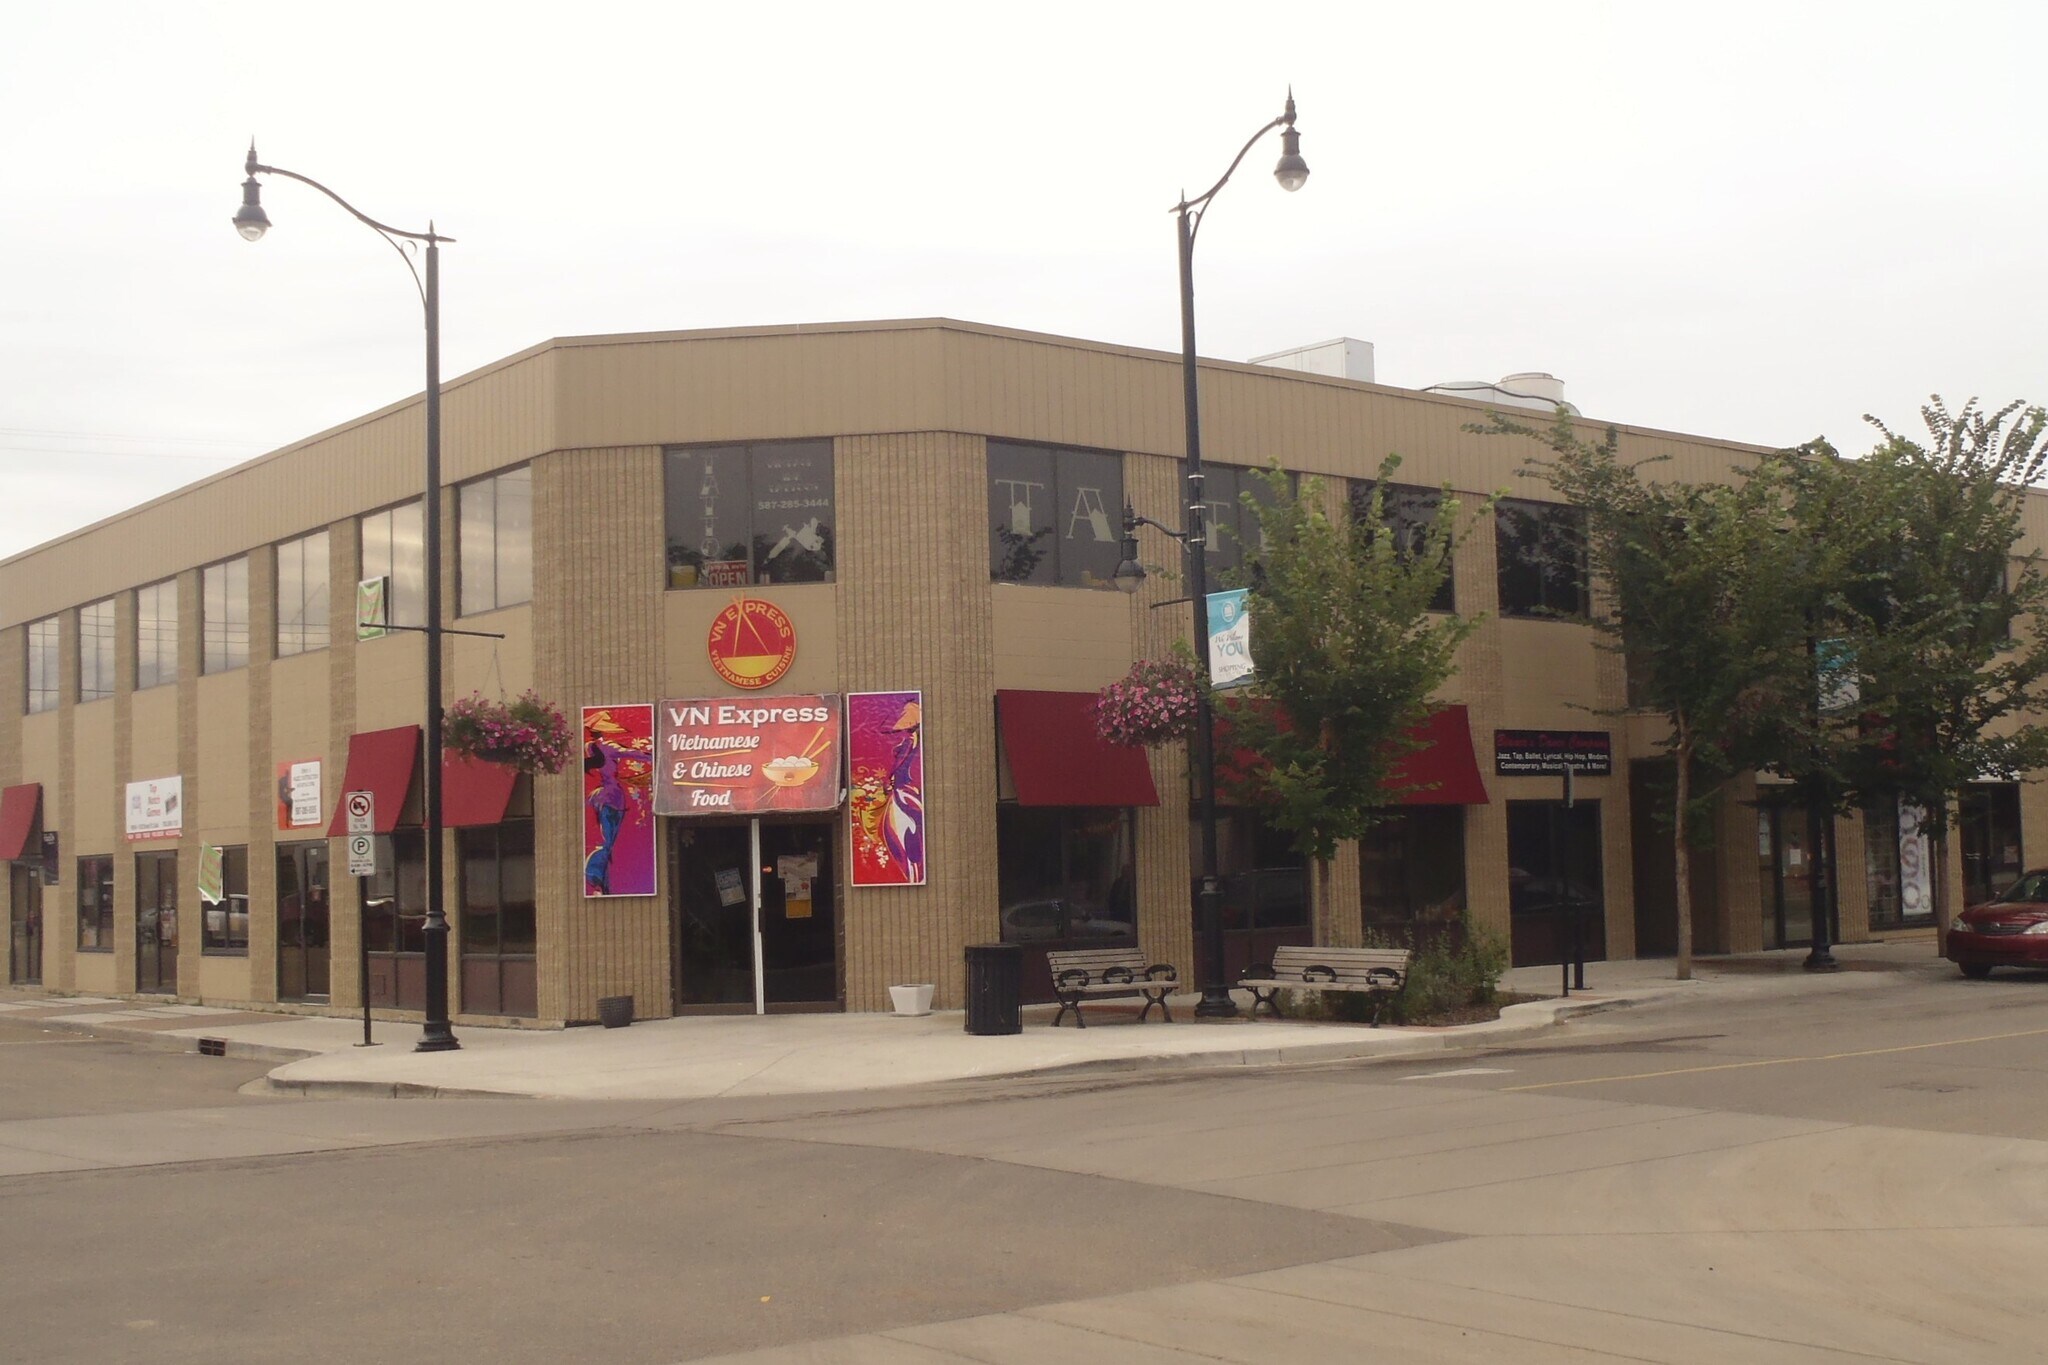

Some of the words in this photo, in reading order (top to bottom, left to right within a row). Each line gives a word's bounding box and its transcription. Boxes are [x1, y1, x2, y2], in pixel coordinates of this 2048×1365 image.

[708, 571, 747, 586] OPEN
[711, 620, 728, 642] VN
[1217, 641, 1243, 658] YOU
[711, 648, 762, 686] VIETNAMESE
[765, 645, 793, 681] CUISINE
[1218, 663, 1246, 673] SHOPPING
[669, 706, 710, 727] VN
[717, 705, 829, 729] Express
[667, 733, 760, 751] Vietnamese
[1512, 752, 1524, 760] Tap,
[672, 763, 687, 780] &
[691, 761, 752, 778] Chinese
[1542, 762, 1563, 770] Musical
[691, 789, 732, 807] Food
